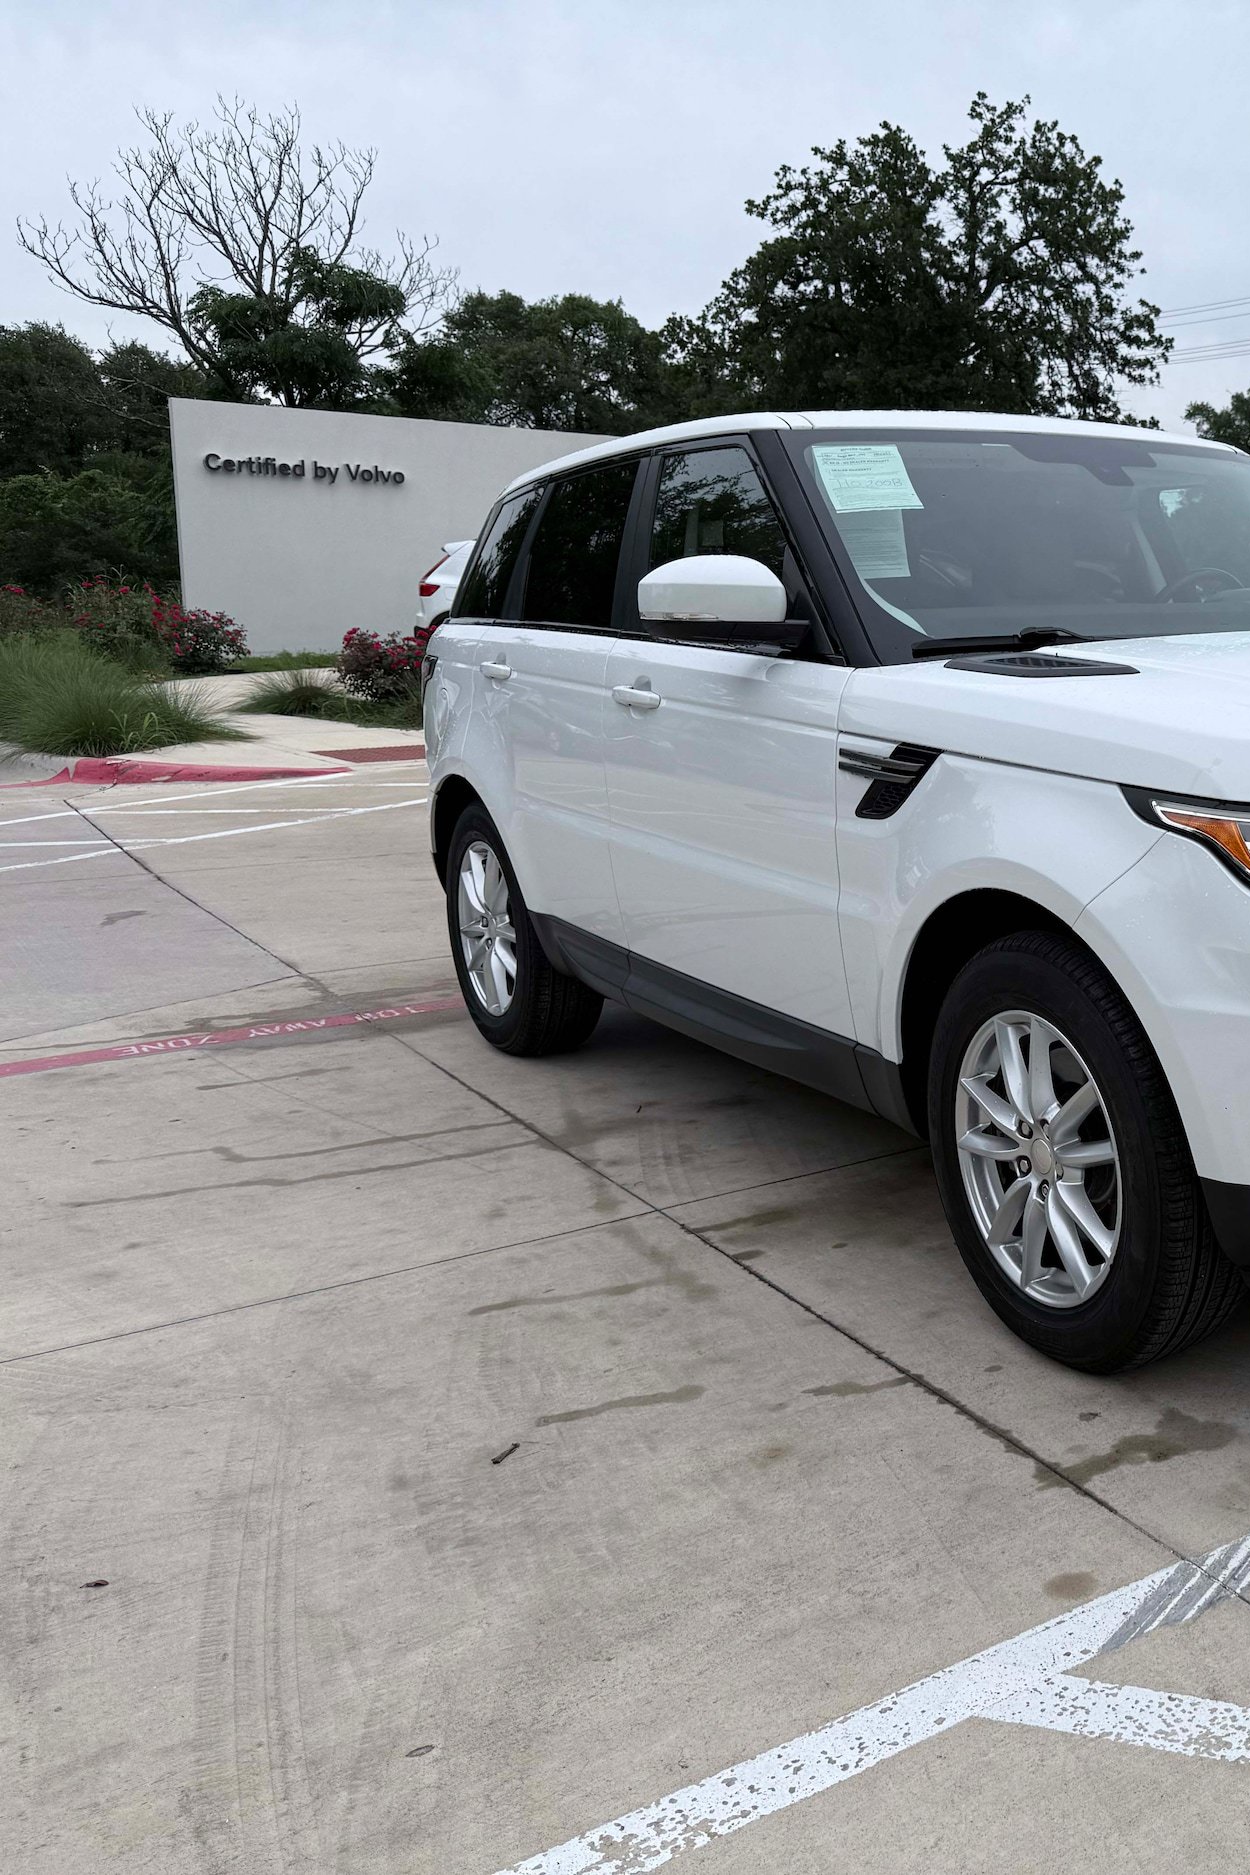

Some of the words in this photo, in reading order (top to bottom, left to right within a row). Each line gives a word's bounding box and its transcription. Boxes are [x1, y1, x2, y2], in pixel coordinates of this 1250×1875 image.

[203, 453, 305, 477] Certified
[313, 461, 339, 484] by
[346, 464, 405, 485] Volvo
[248, 1018, 326, 1038] AWAY
[118, 1034, 221, 1057] ZONE
